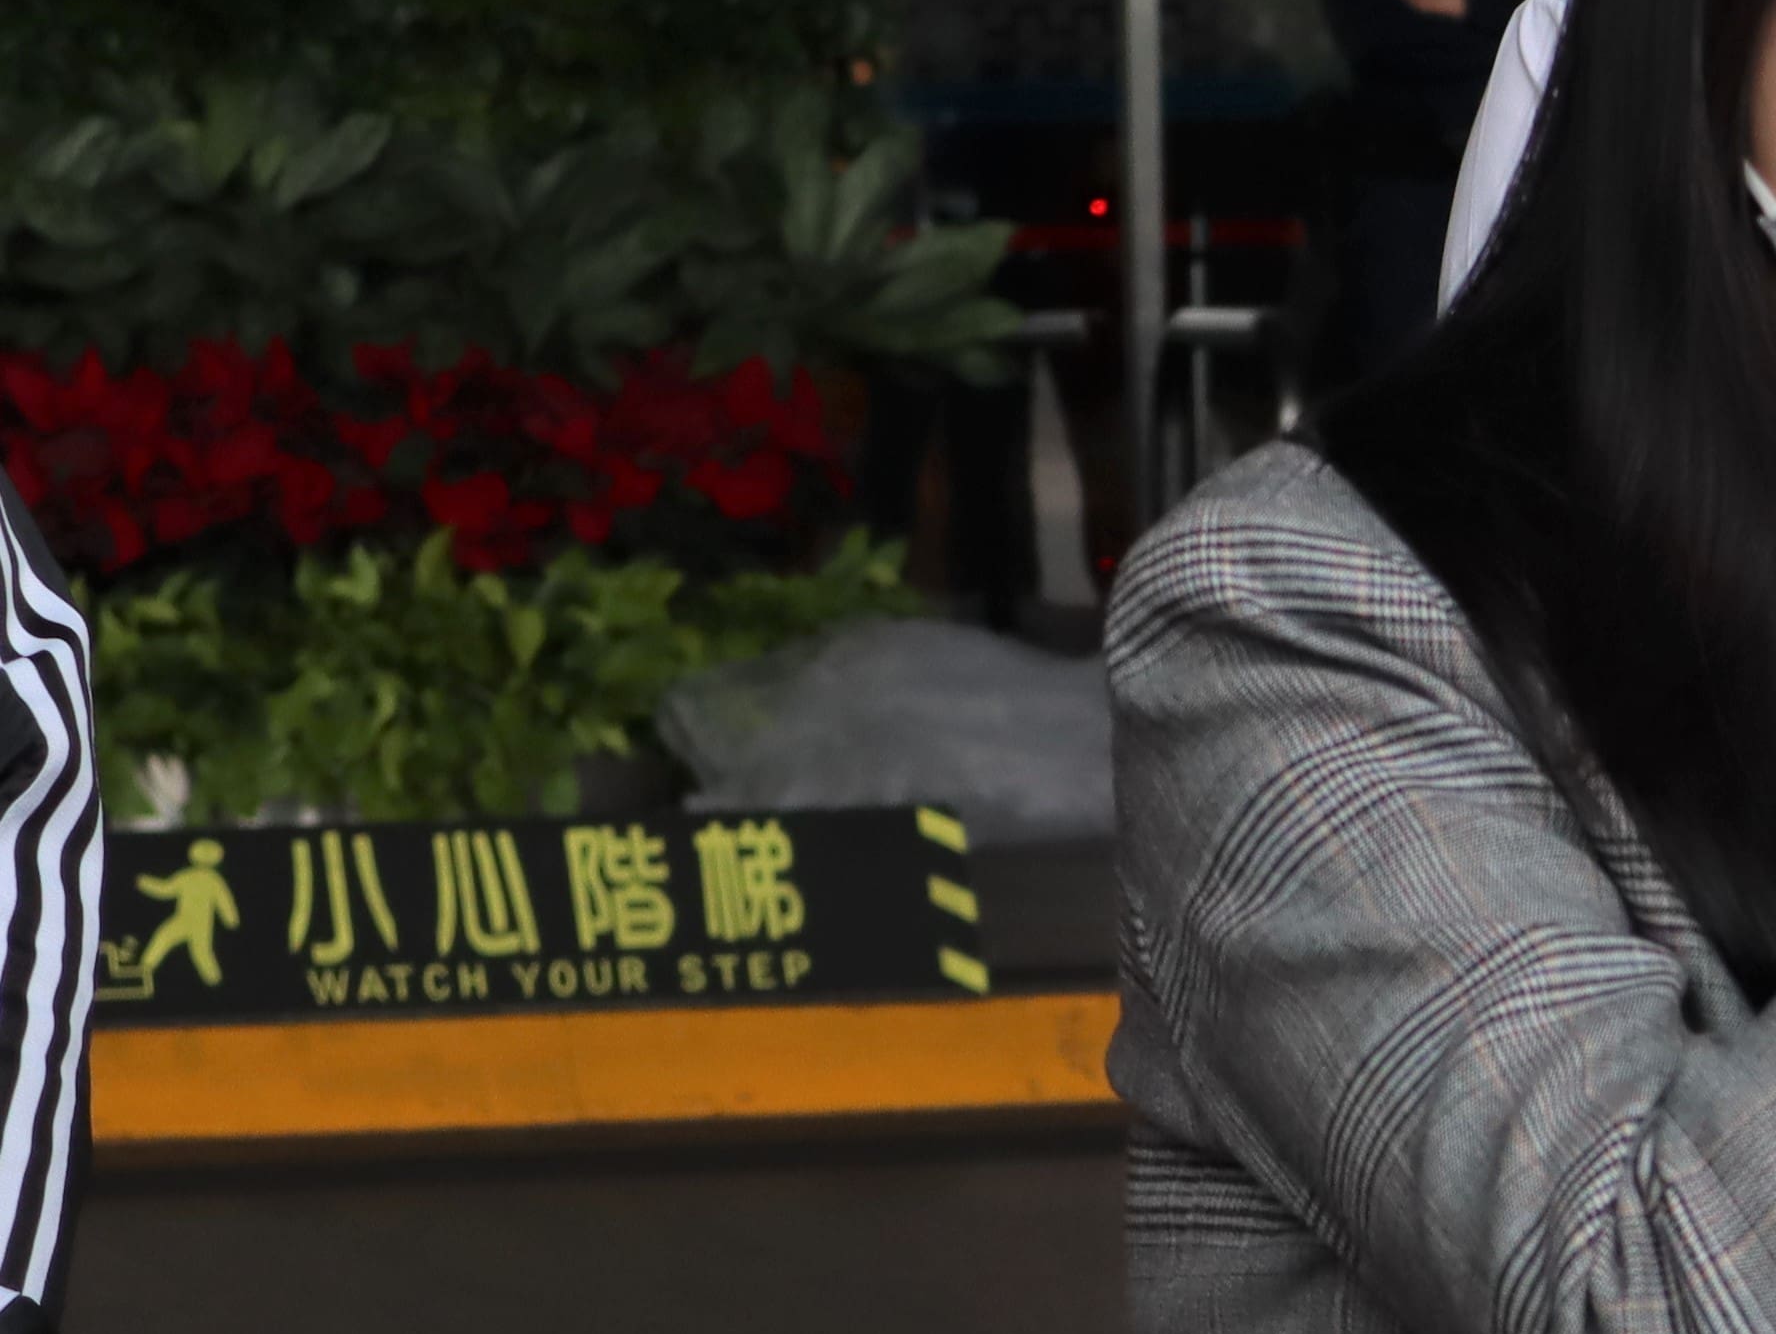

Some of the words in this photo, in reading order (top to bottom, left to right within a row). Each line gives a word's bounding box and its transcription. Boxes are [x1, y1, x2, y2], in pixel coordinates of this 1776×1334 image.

[288, 817, 806, 966] 小心階梯
[306, 964, 489, 1006] WATCH
[510, 957, 649, 1000] YOUR
[676, 950, 812, 993] STEP
